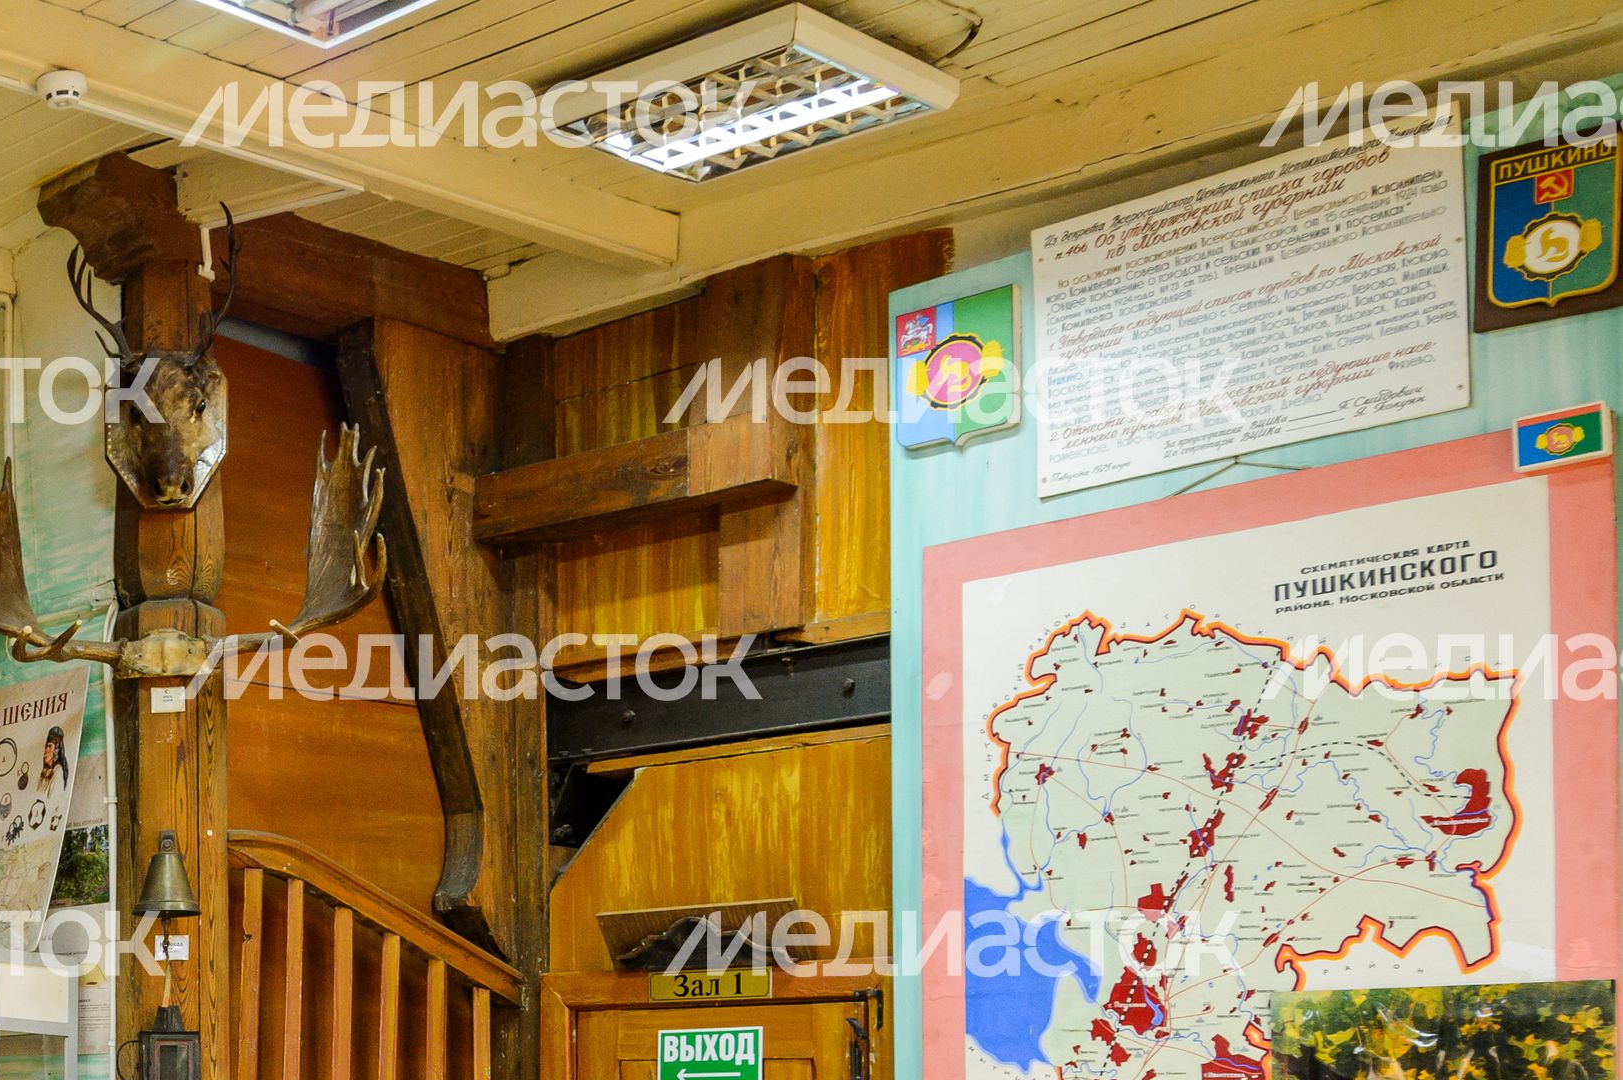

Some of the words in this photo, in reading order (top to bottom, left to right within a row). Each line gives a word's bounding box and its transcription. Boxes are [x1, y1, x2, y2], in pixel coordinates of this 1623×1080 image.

[1301, 548, 1420, 574] СХЕМАТИЧЕСКАЯ
[1426, 540, 1470, 554] КАРТА
[1274, 550, 1498, 602] ПУШКИНСКОГО
[1339, 581, 1434, 604] МОСКОВСКОЙ
[1440, 572, 1504, 590] ОБЛАСТИ
[673, 974, 720, 997] Зал
[733, 972, 745, 995] 1
[663, 1032, 756, 1066] ВЫХОД
